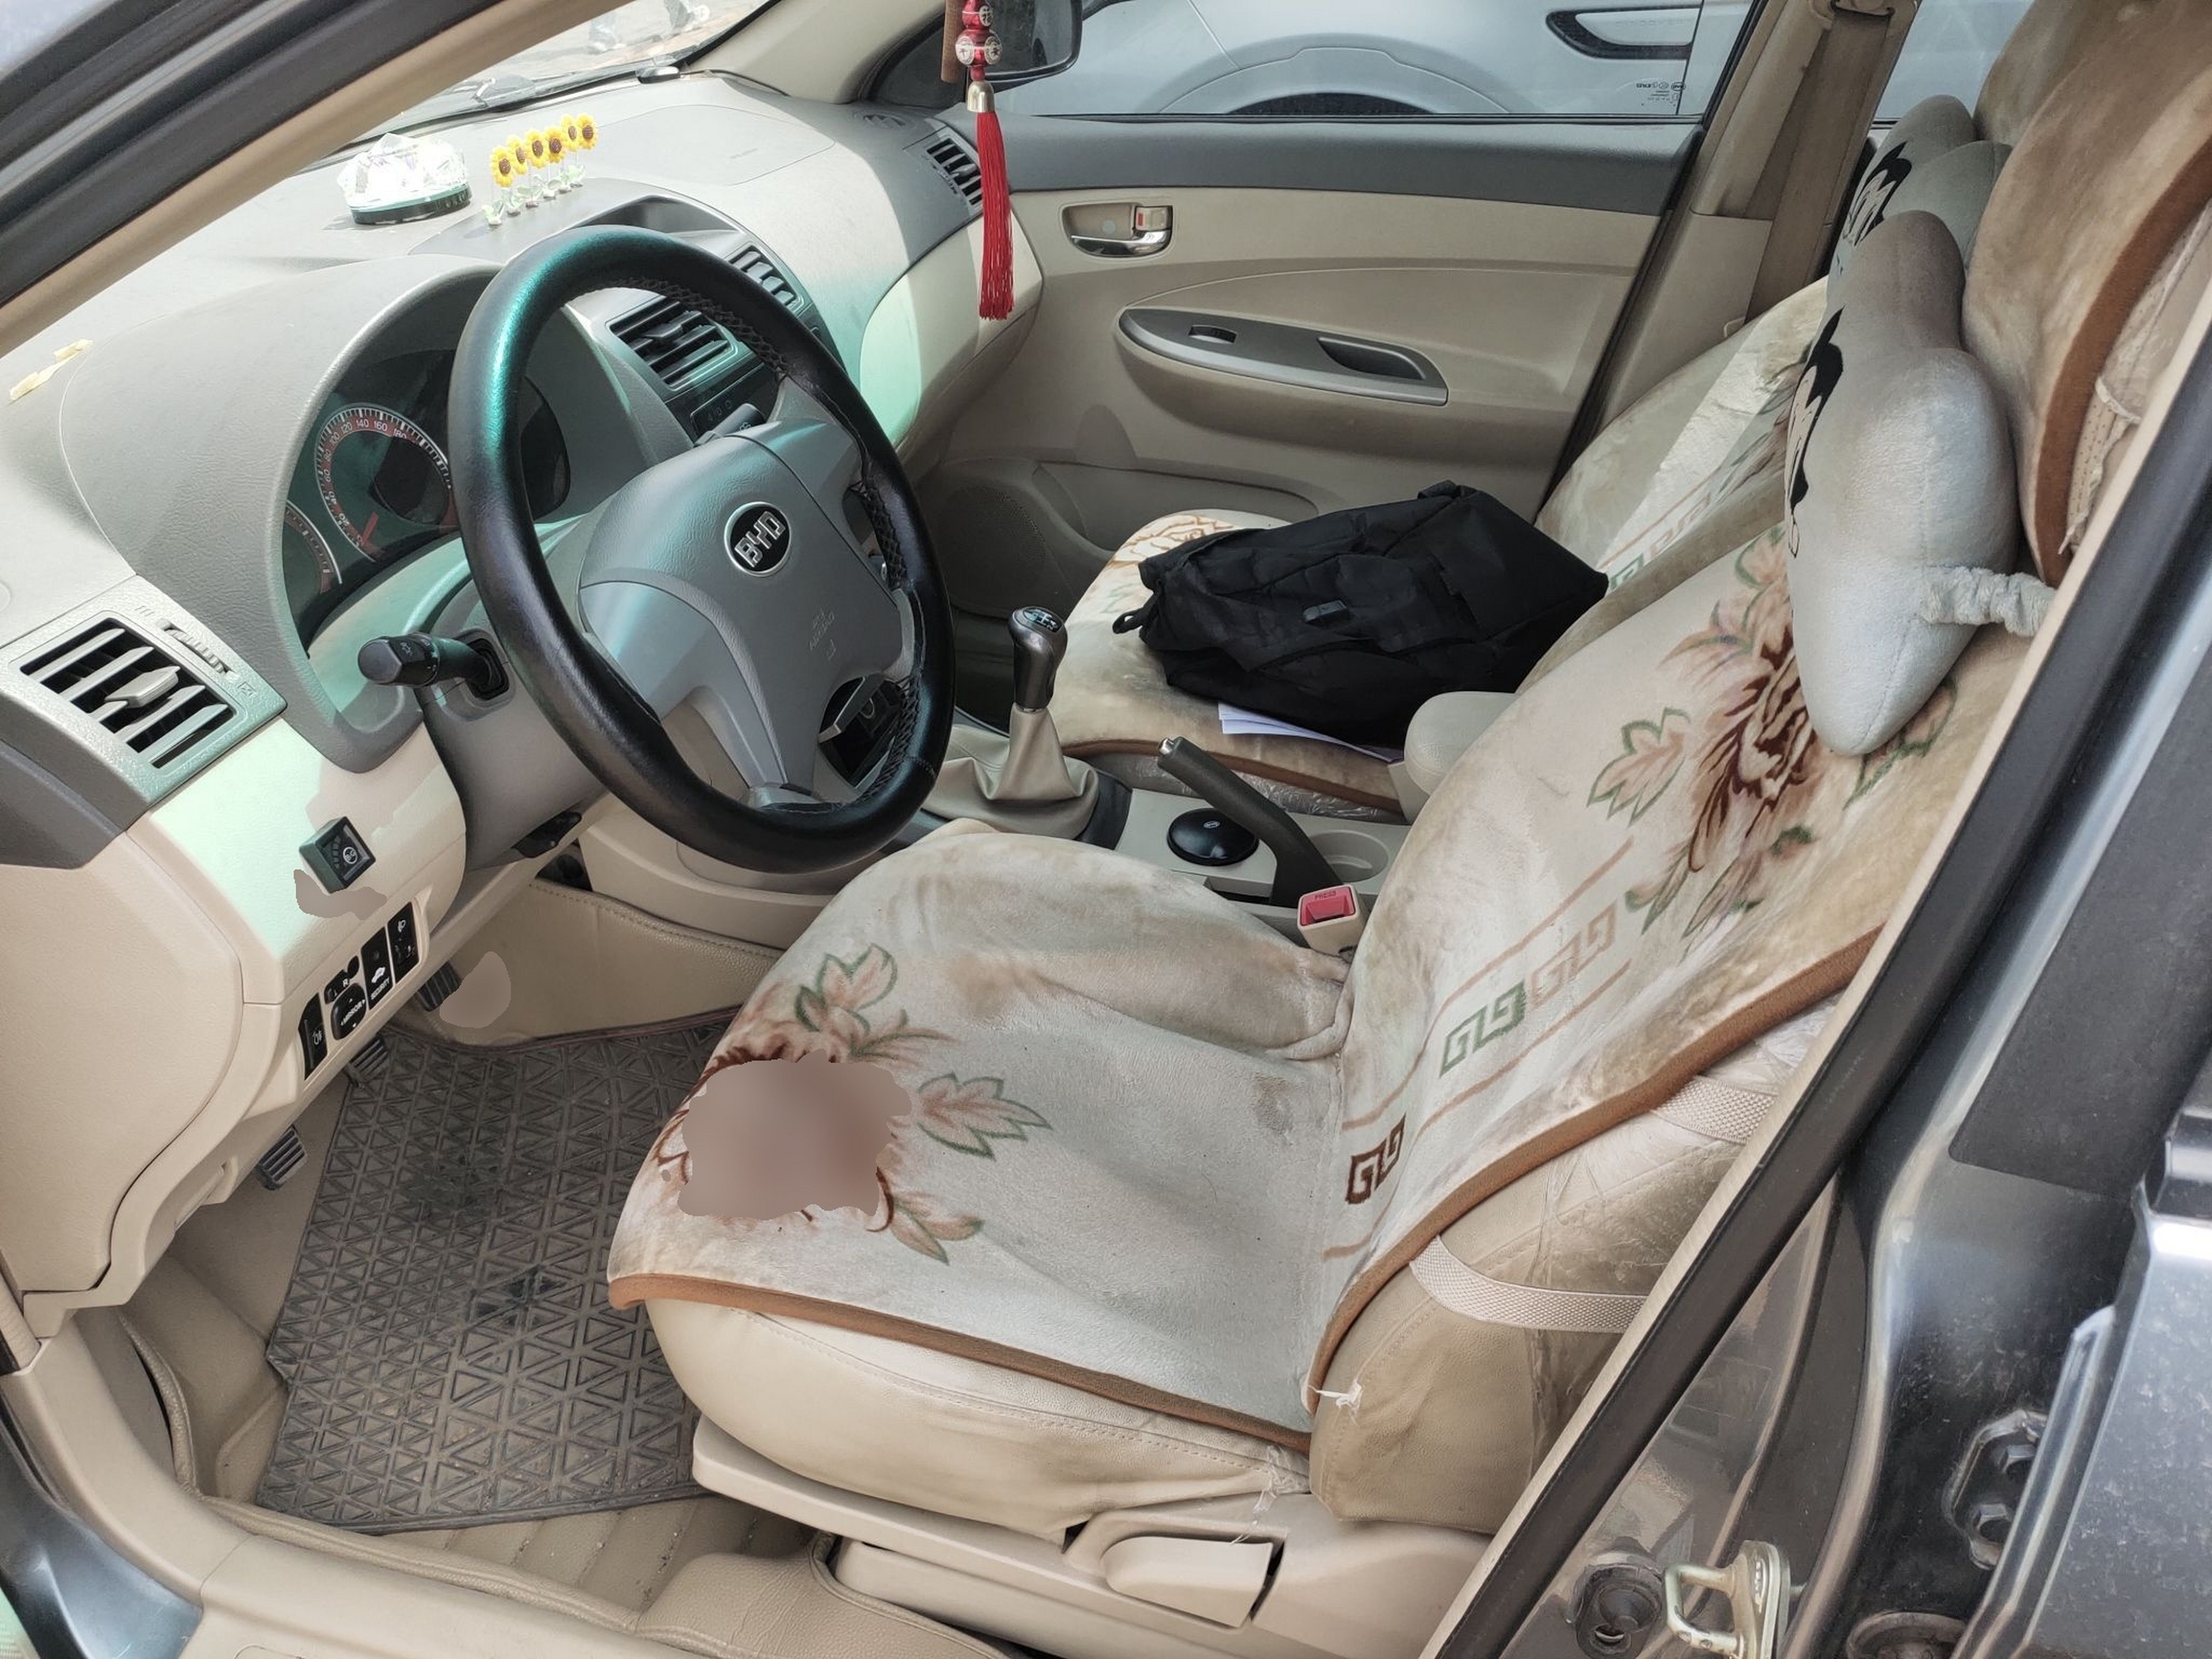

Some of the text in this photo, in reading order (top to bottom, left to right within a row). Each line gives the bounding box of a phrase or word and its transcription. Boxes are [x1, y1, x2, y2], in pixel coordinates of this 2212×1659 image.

[341, 422, 353, 434] 120
[356, 419, 369, 428] 140
[373, 421, 388, 431] 160
[329, 431, 340, 444] 100
[393, 428, 407, 439] 180
[323, 449, 331, 461] 80
[323, 469, 331, 482] 60
[328, 491, 337, 505] 40
[734, 511, 786, 567] BYD
[1315, 891, 1337, 900] PRESS
[343, 978, 349, 987] R
[371, 978, 390, 999] SECURITY
[343, 1002, 363, 1024] MIRROR
